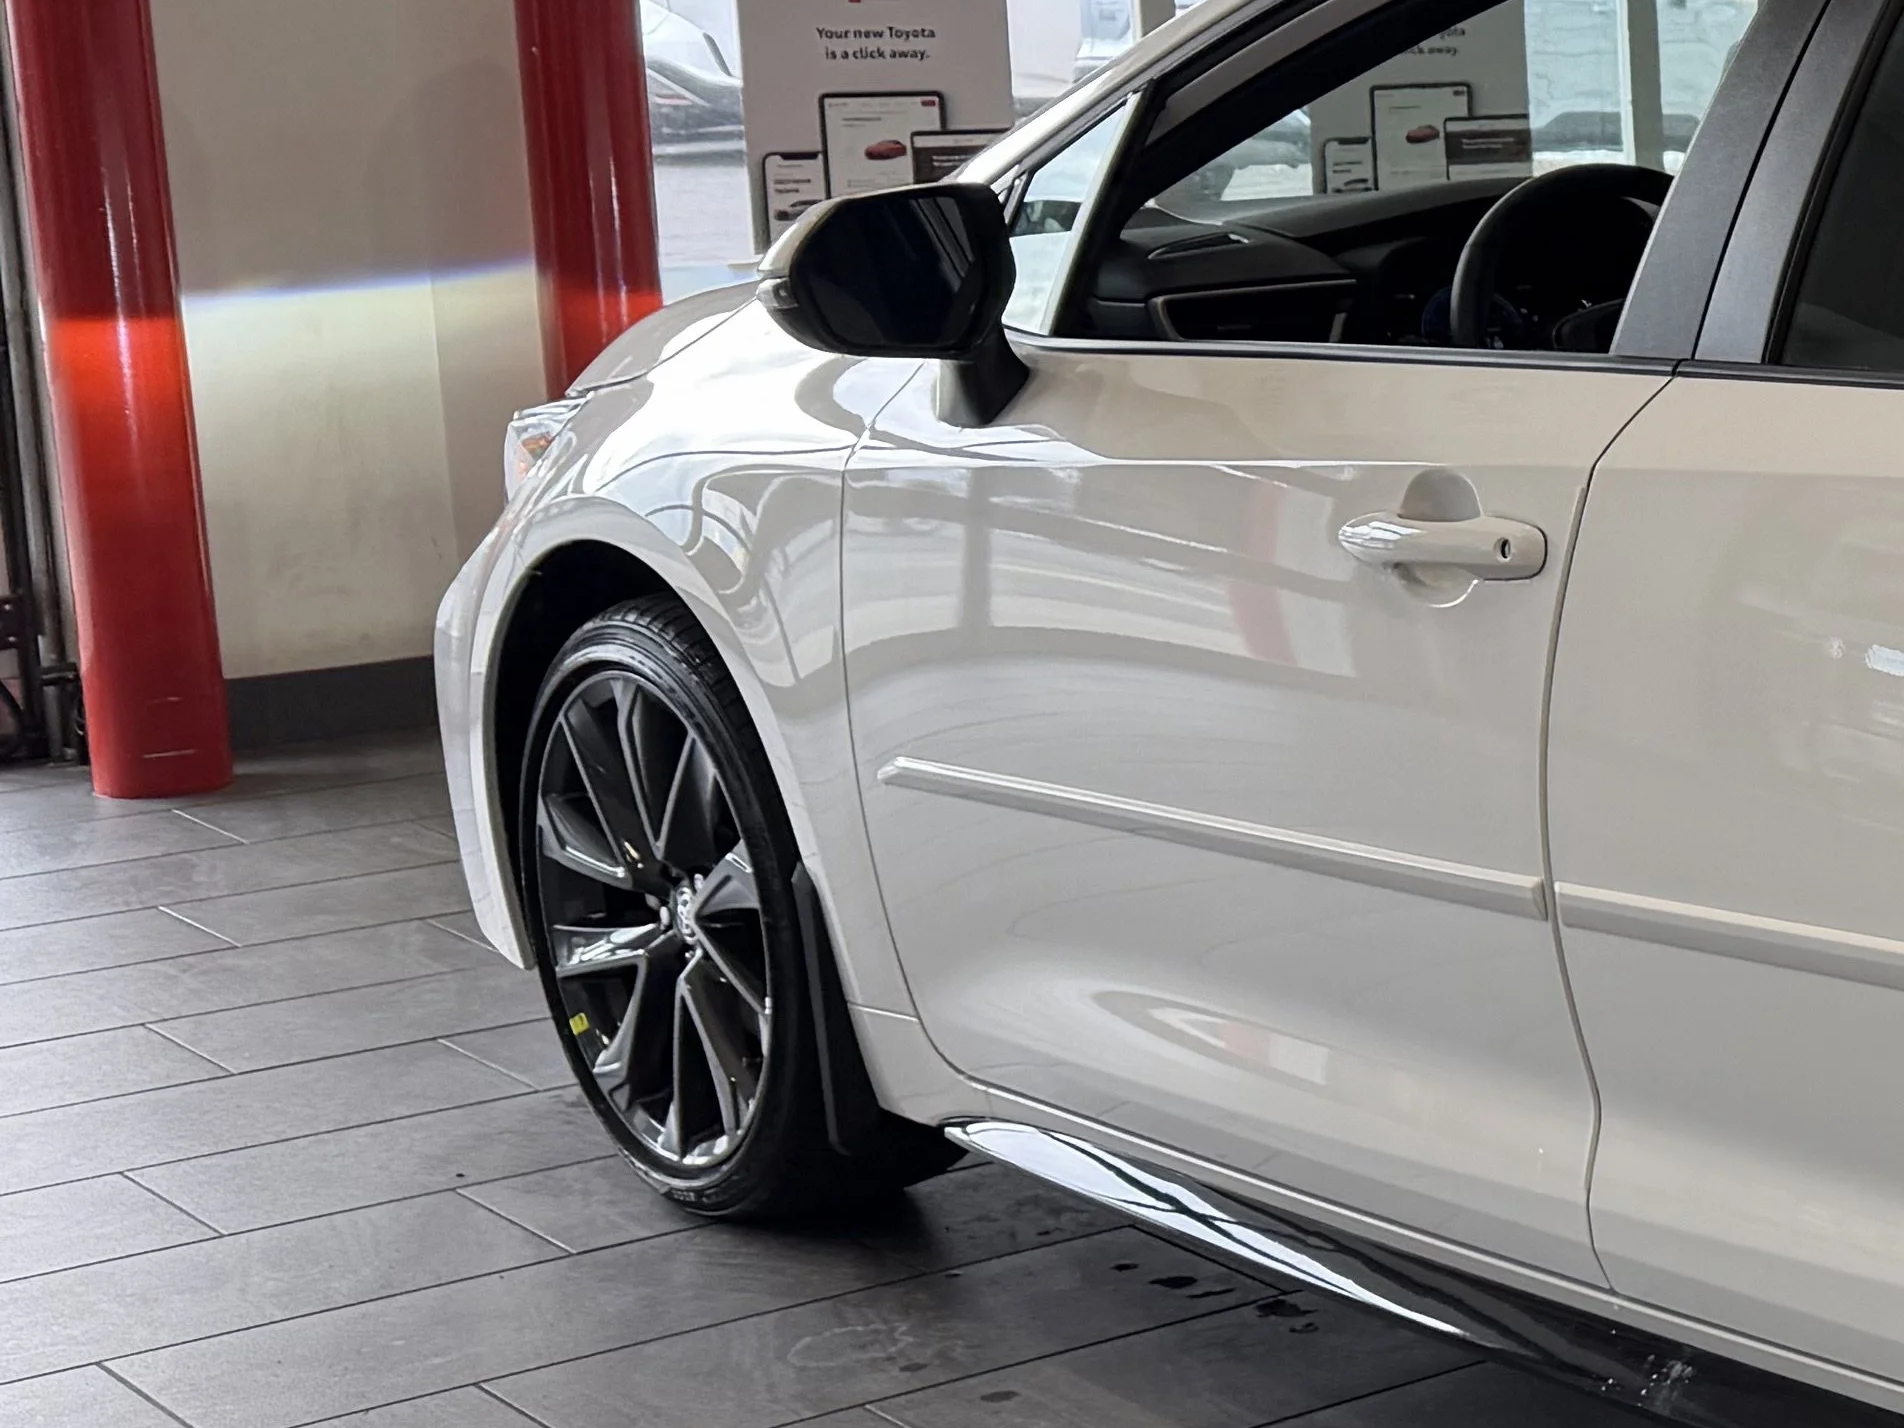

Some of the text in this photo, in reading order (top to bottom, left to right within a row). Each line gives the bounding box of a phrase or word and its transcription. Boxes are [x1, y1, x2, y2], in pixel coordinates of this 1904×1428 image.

[816, 25, 936, 42] Your new Toyota
[825, 46, 931, 61] is a click away.
